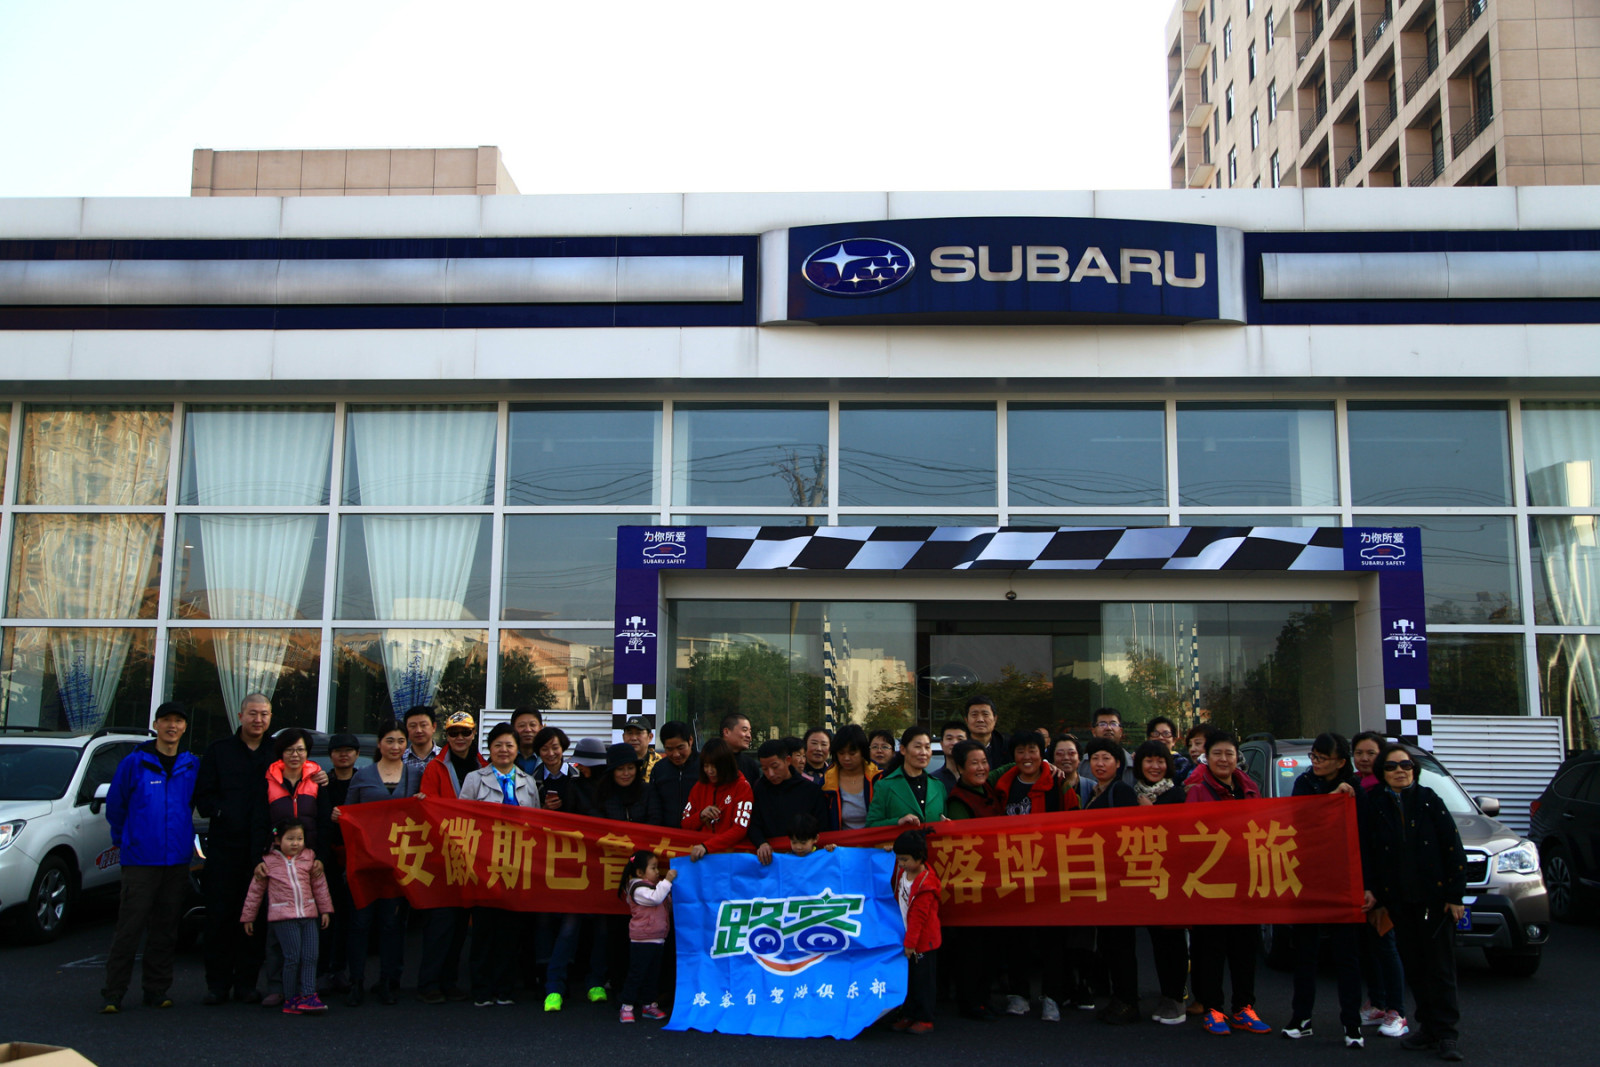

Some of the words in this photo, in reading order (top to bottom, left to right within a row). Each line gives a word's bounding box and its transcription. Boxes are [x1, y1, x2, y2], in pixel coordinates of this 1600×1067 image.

[930, 245, 1206, 288] SUBARU
[643, 531, 686, 542] 为你所爱
[1360, 532, 1404, 544] 为你所爱
[931, 819, 1303, 905] 落坪自驾之旅
